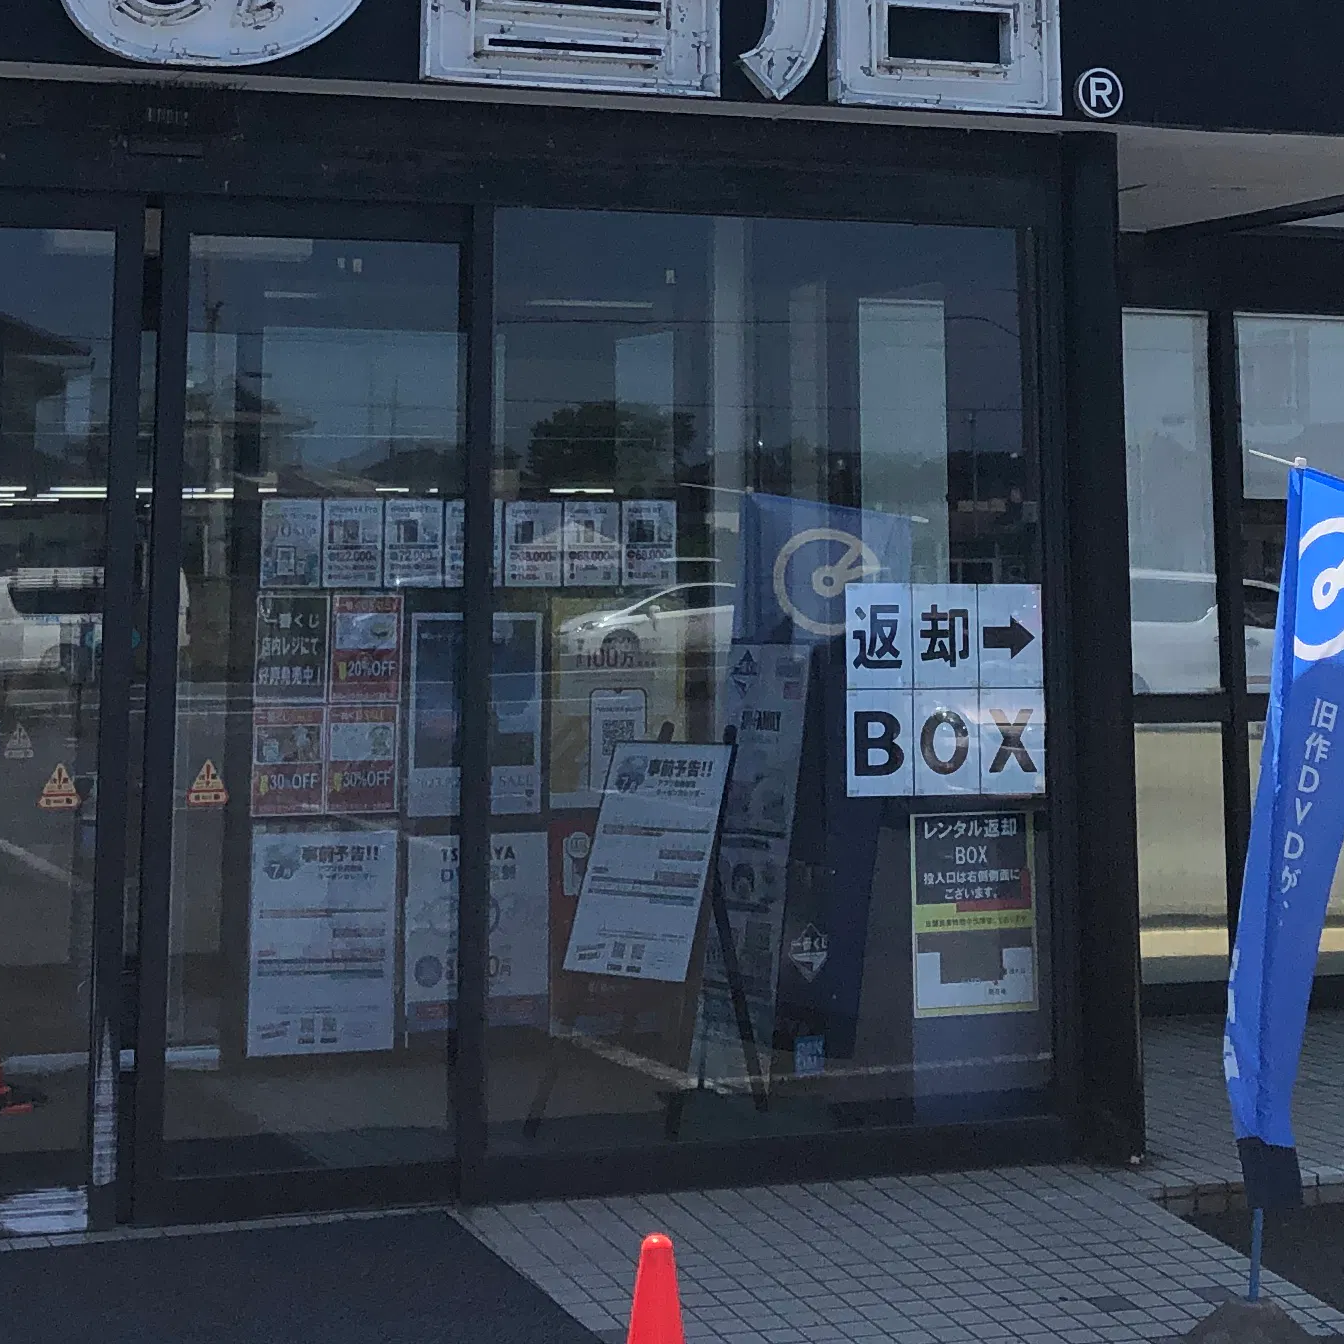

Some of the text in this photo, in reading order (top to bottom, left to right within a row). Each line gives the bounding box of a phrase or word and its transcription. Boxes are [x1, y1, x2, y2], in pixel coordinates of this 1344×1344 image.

[852, 604, 969, 671] 返却
[853, 706, 1039, 779] BOX
[923, 817, 1018, 839] レンタル返却
[955, 845, 988, 865] BOX
